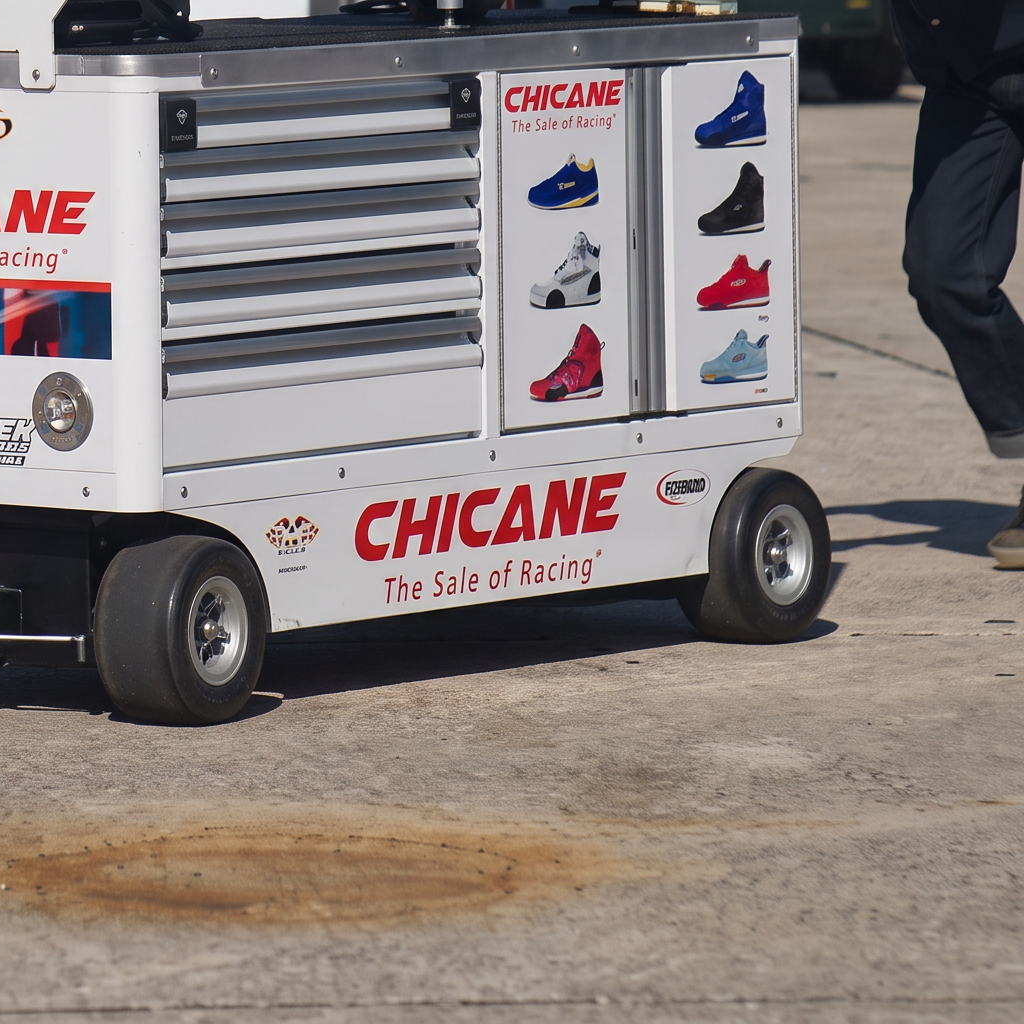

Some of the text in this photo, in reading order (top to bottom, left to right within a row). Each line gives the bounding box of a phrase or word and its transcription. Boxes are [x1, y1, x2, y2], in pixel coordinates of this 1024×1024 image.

[504, 79, 625, 113] CHICANE
[511, 119, 531, 133] The
[535, 117, 558, 132] Sale
[561, 115, 573, 130] of
[354, 471, 628, 562] CHICANE
[383, 574, 423, 605] The
[432, 566, 479, 598] Sale
[488, 559, 514, 589] of
